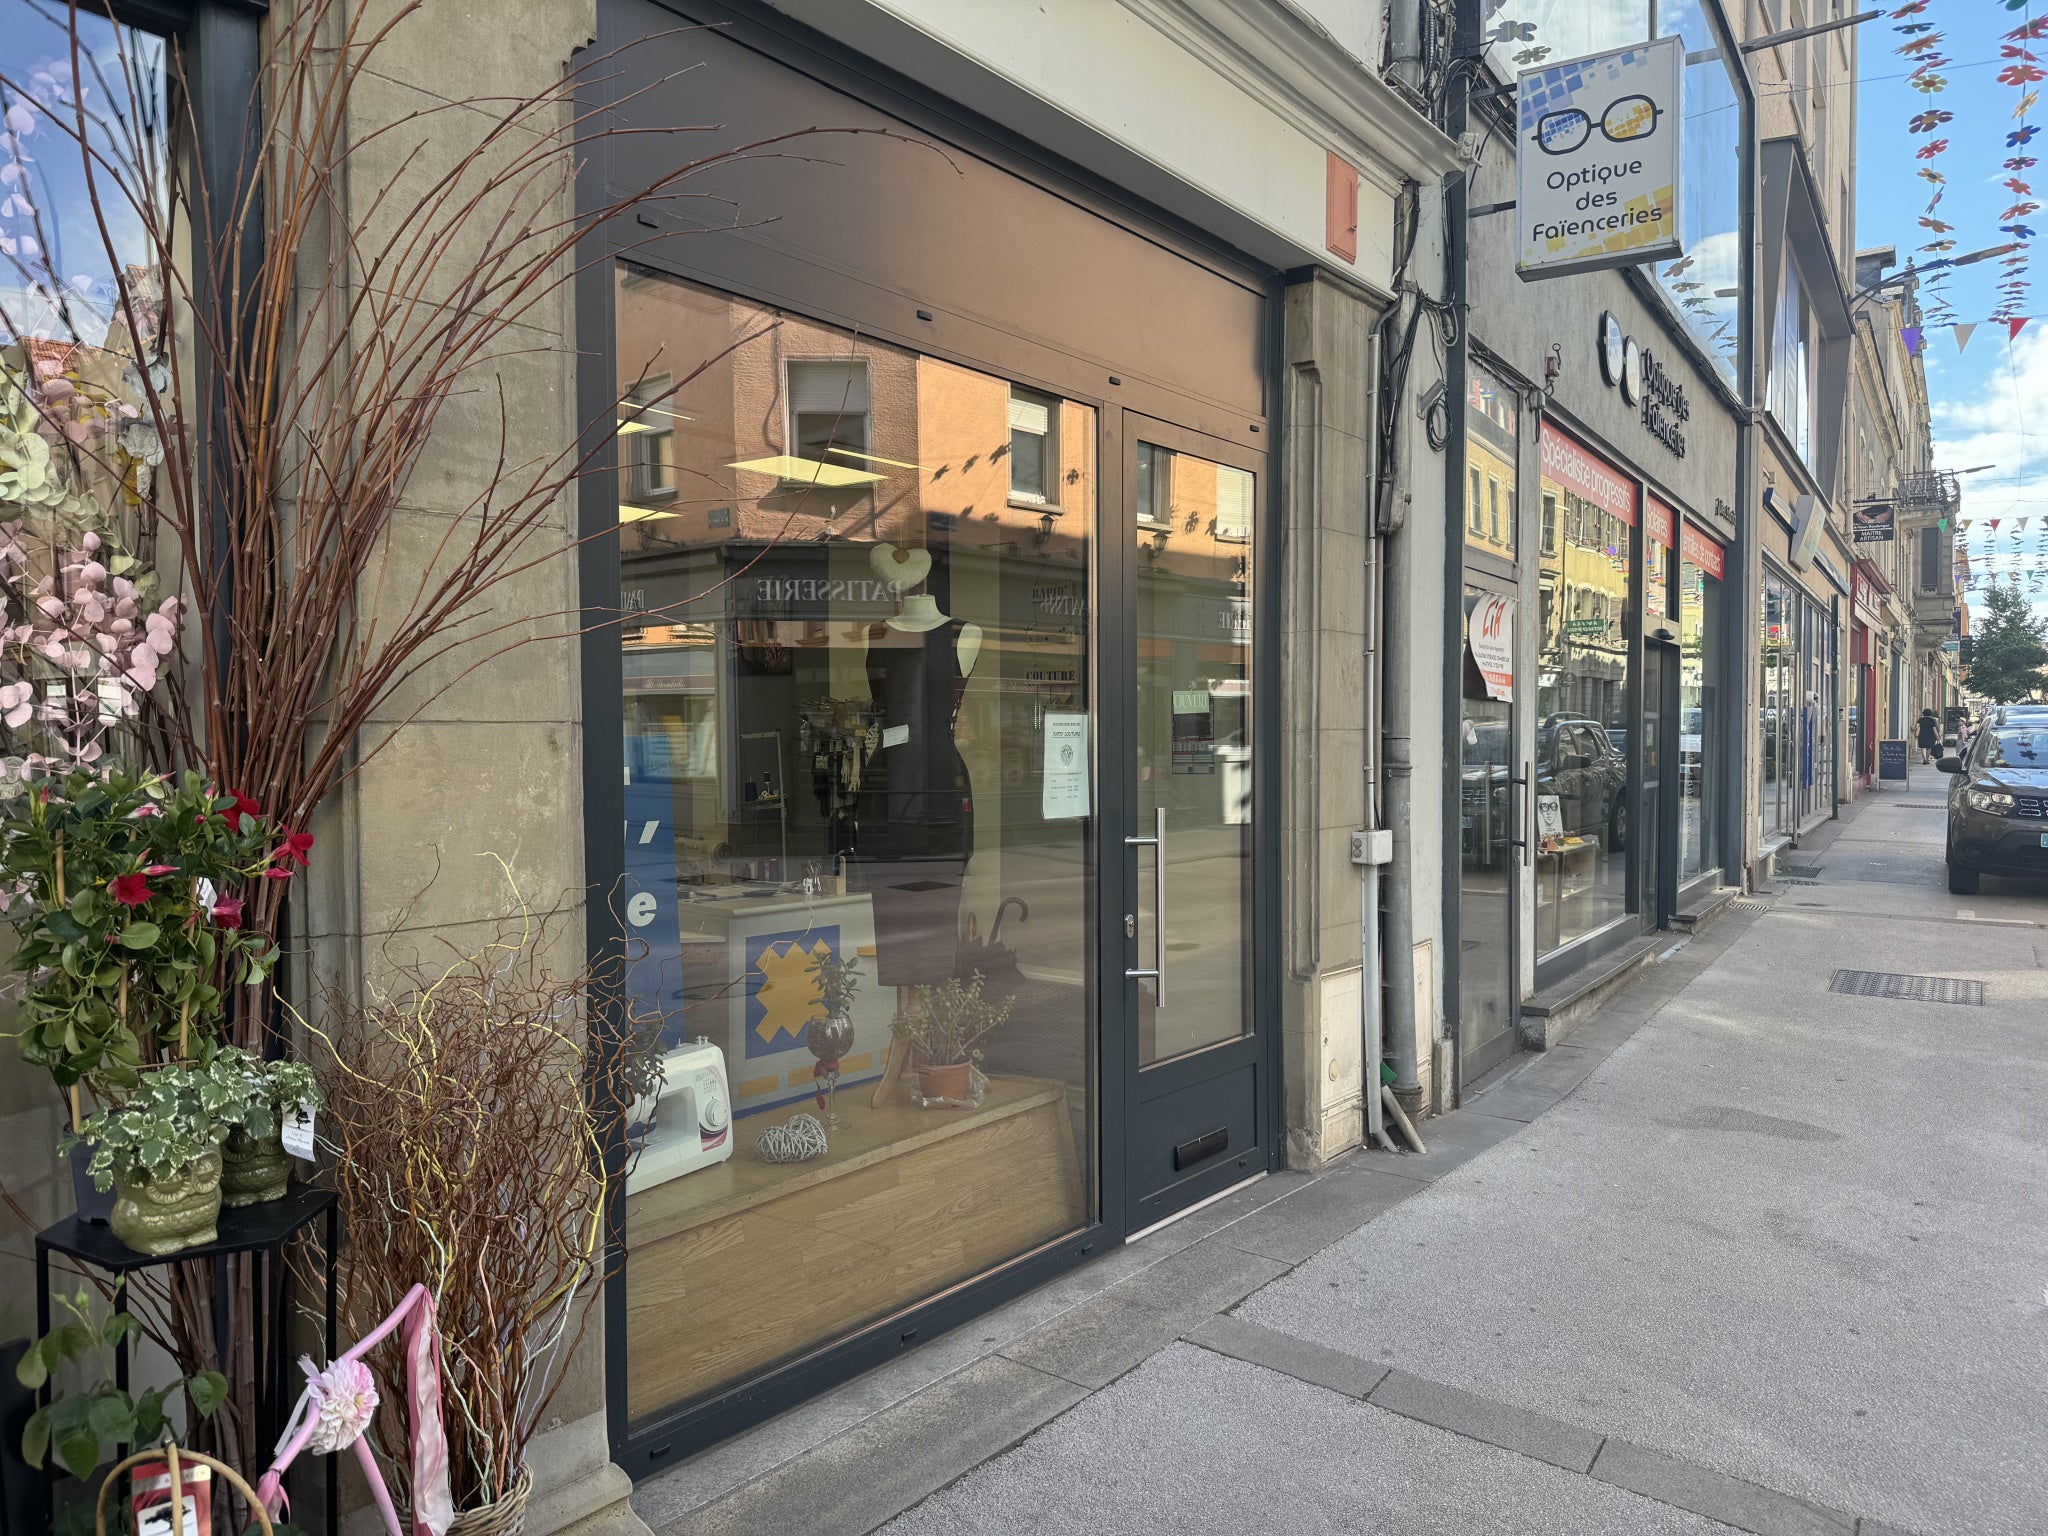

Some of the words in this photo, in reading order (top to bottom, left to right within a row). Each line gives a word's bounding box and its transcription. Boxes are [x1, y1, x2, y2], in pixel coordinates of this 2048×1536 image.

[1546, 159, 1643, 191] Optique
[1575, 190, 1618, 211] des
[1532, 207, 1663, 242] Faïenceries
[1542, 428, 1591, 488] Spécialiste
[1590, 469, 1631, 513] progressifs
[1647, 502, 1668, 539] Solaires
[1683, 533, 1699, 559] entilles
[1026, 670, 1075, 681] COUTURE
[1174, 694, 1208, 709] OUVERT
